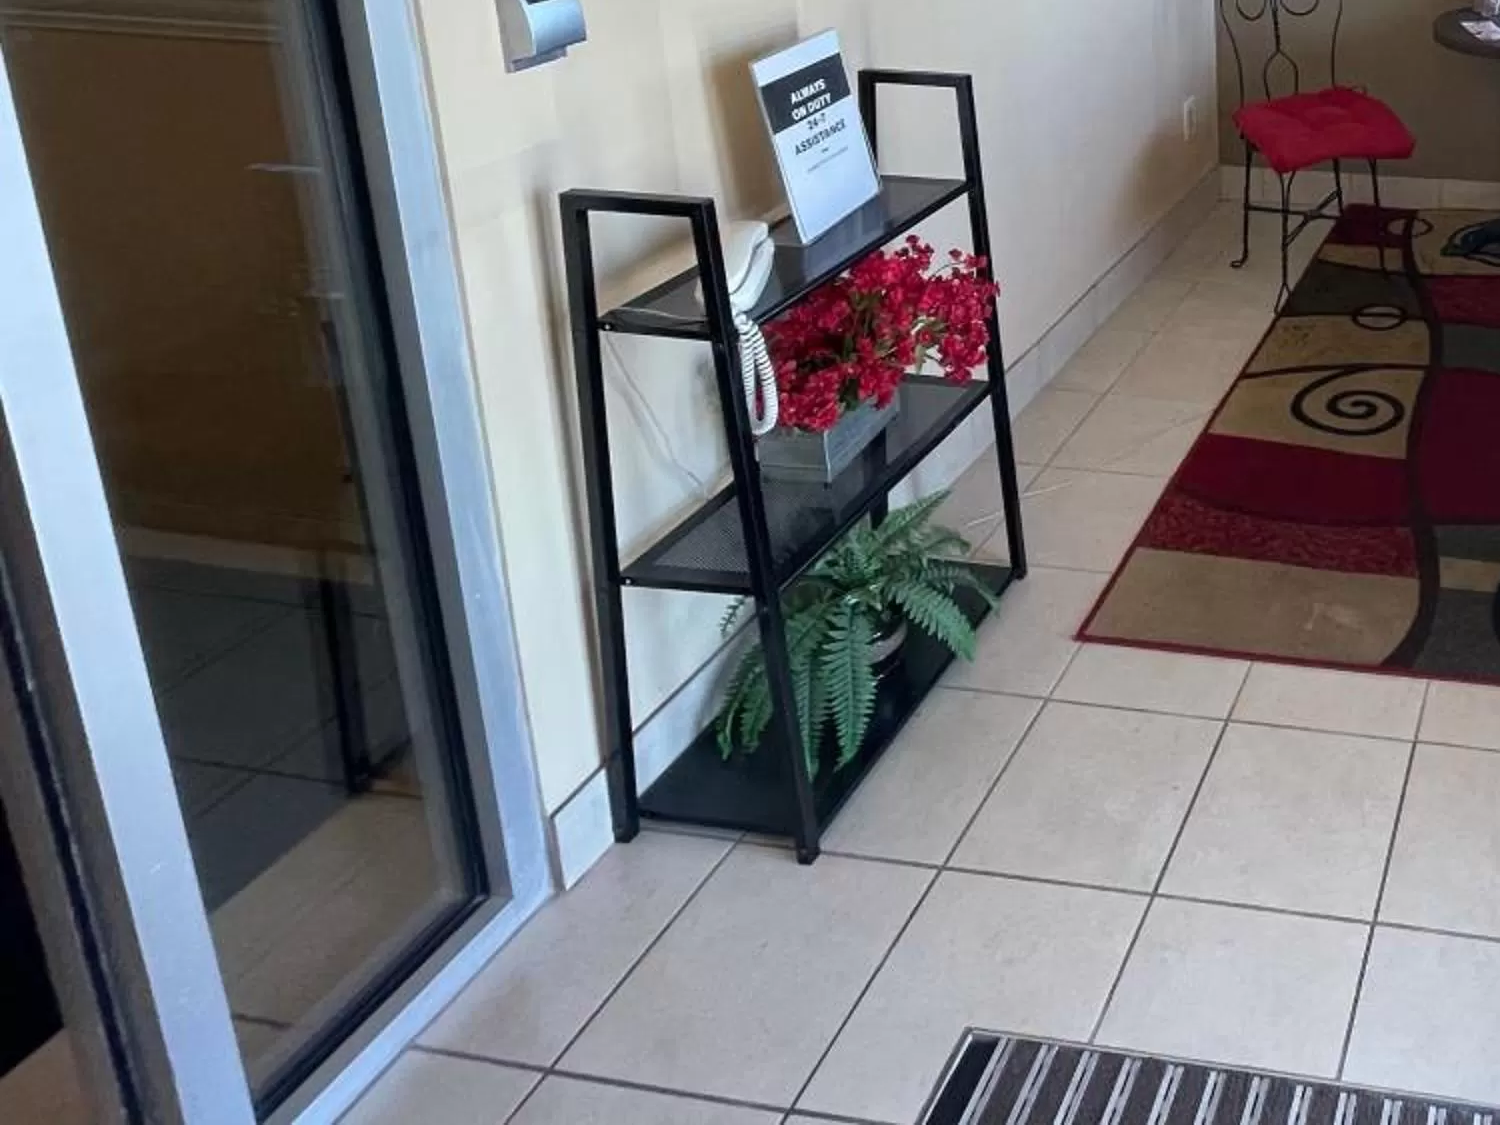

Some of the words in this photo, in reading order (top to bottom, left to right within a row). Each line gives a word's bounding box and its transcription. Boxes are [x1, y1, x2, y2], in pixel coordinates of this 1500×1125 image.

[790, 78, 827, 105] ALWAYS
[791, 104, 808, 122] ON
[807, 92, 832, 112] DUTY
[794, 118, 846, 156] ASSISTANCE
